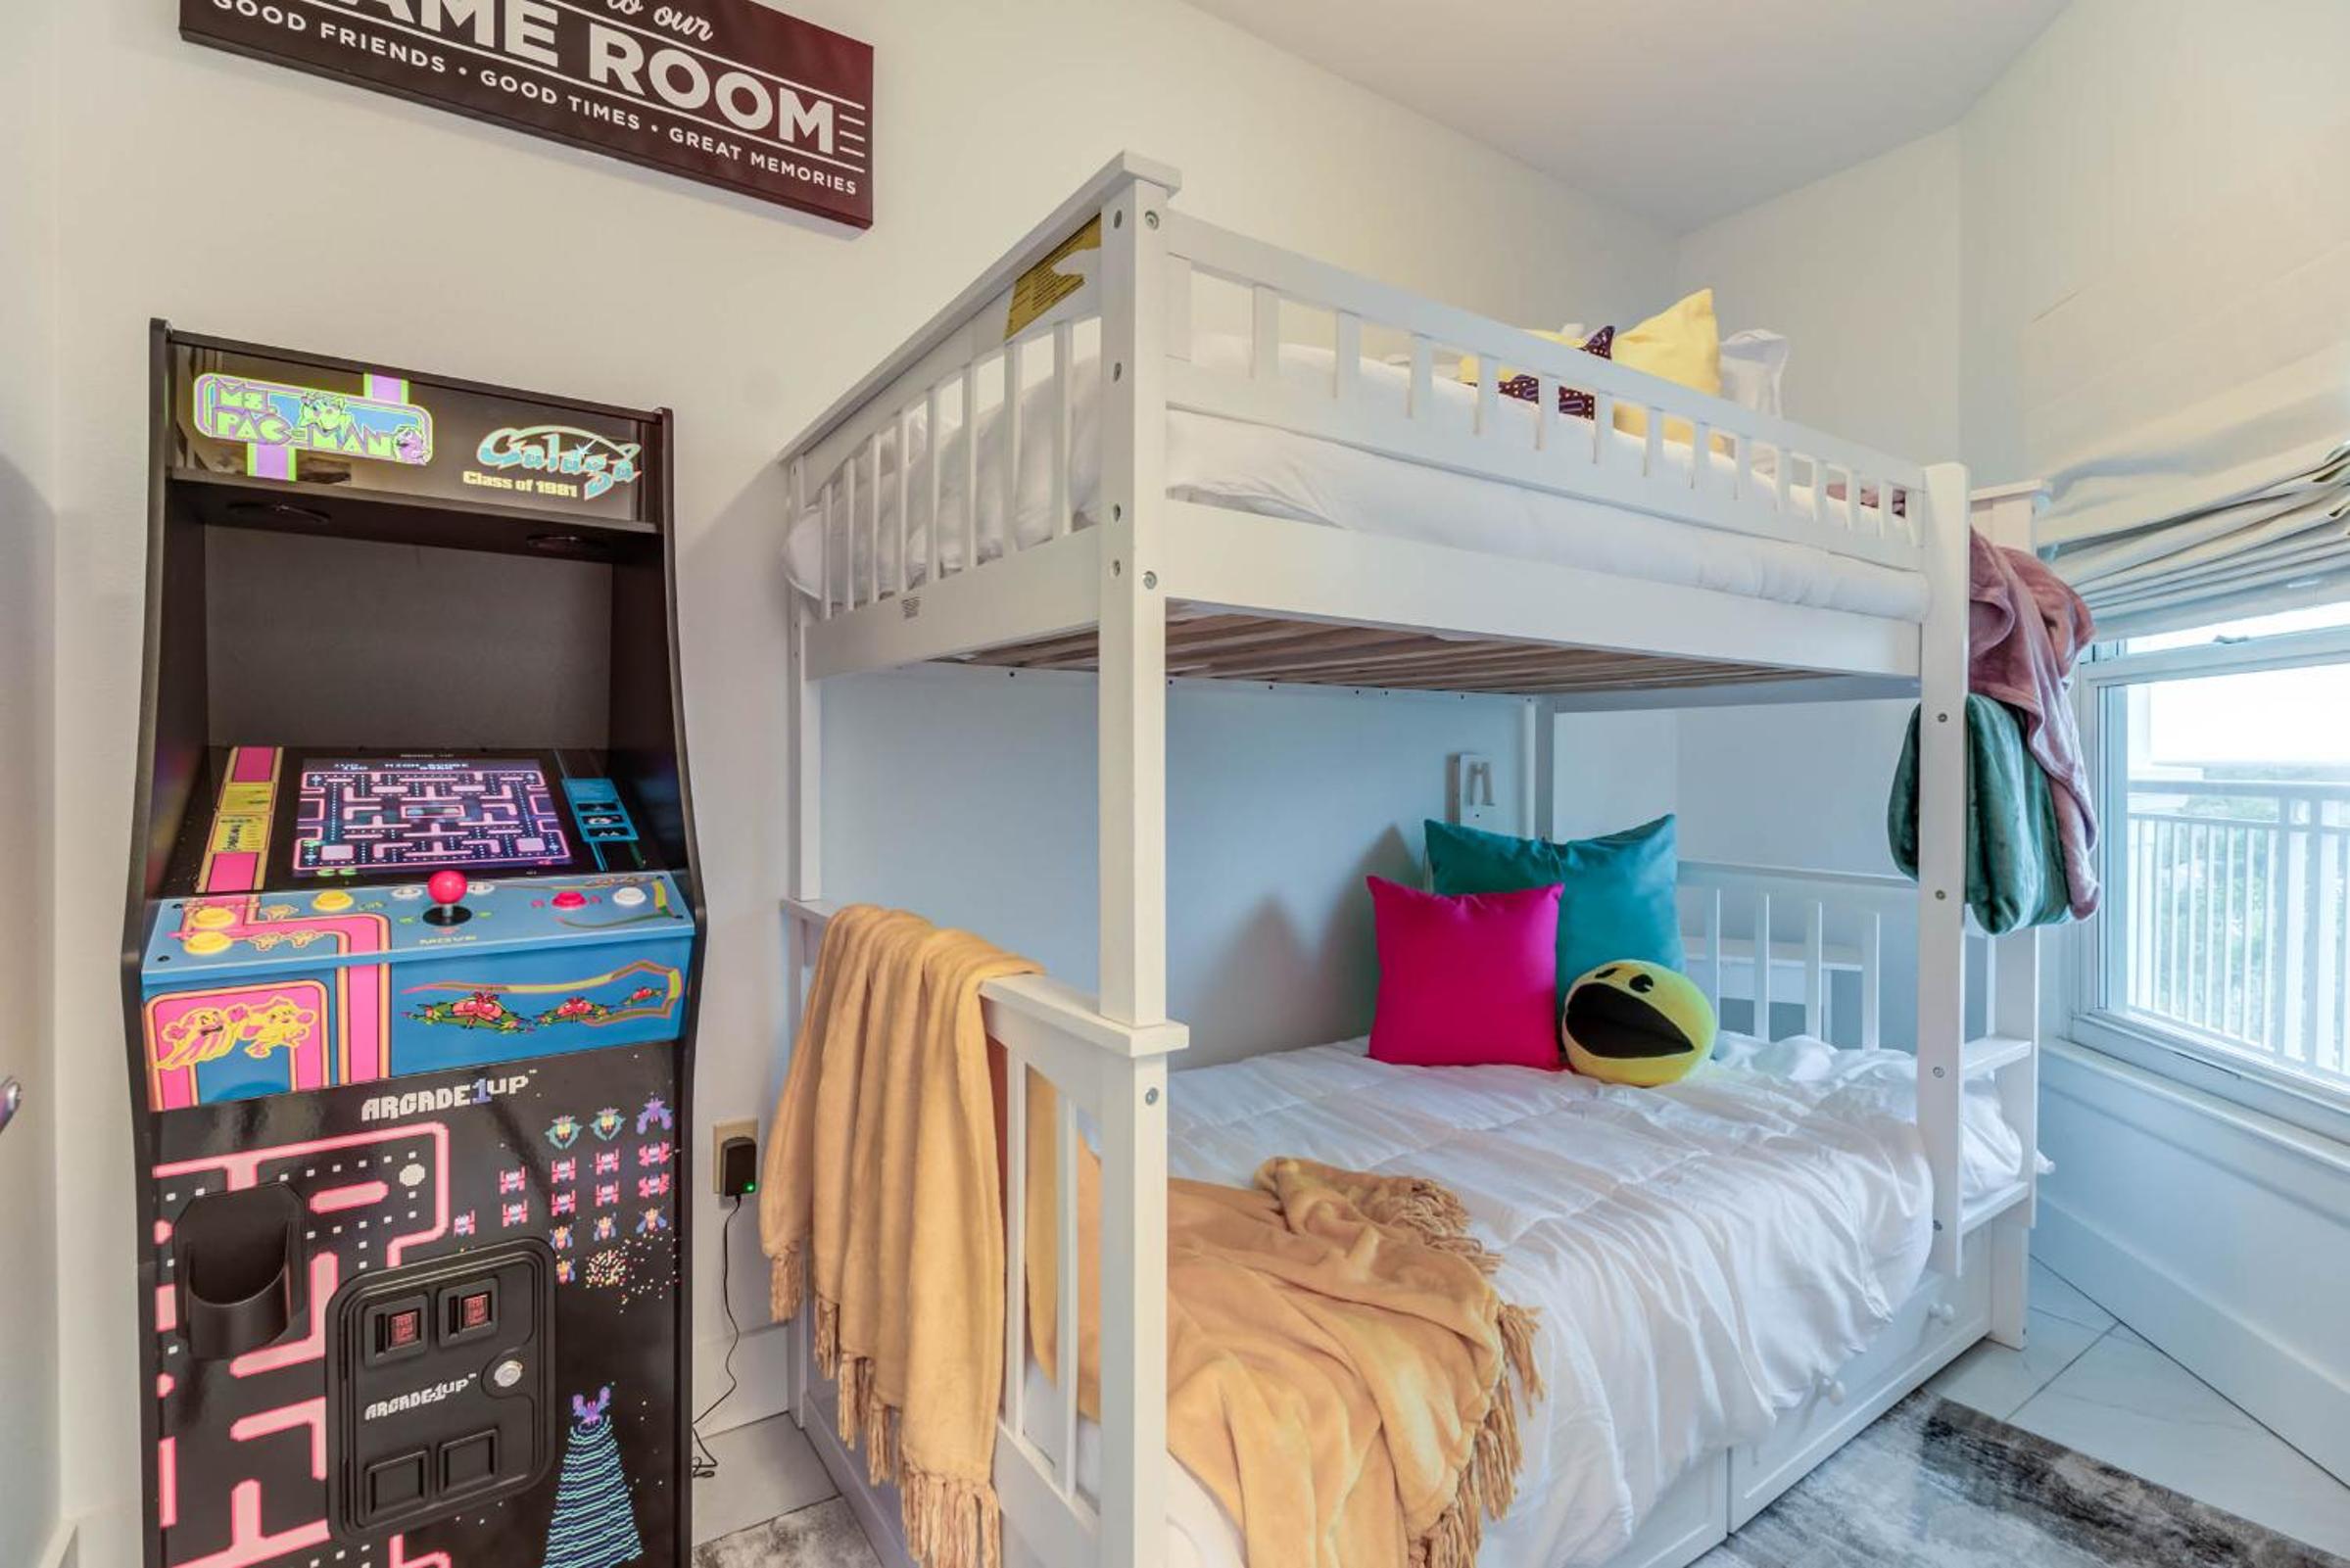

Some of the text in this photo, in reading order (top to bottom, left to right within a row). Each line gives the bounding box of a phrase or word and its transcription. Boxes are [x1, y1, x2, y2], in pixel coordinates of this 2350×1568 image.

[653, 6, 713, 41] our
[320, 22, 446, 72] FRIENDS
[480, 70, 557, 104] GOOD
[567, 96, 641, 130] TIMES
[669, 127, 742, 161] GREAT
[750, 152, 857, 195] MEMORIES
[334, 0, 834, 154] ME ROOM
[462, 470, 578, 498] Class of 1981
